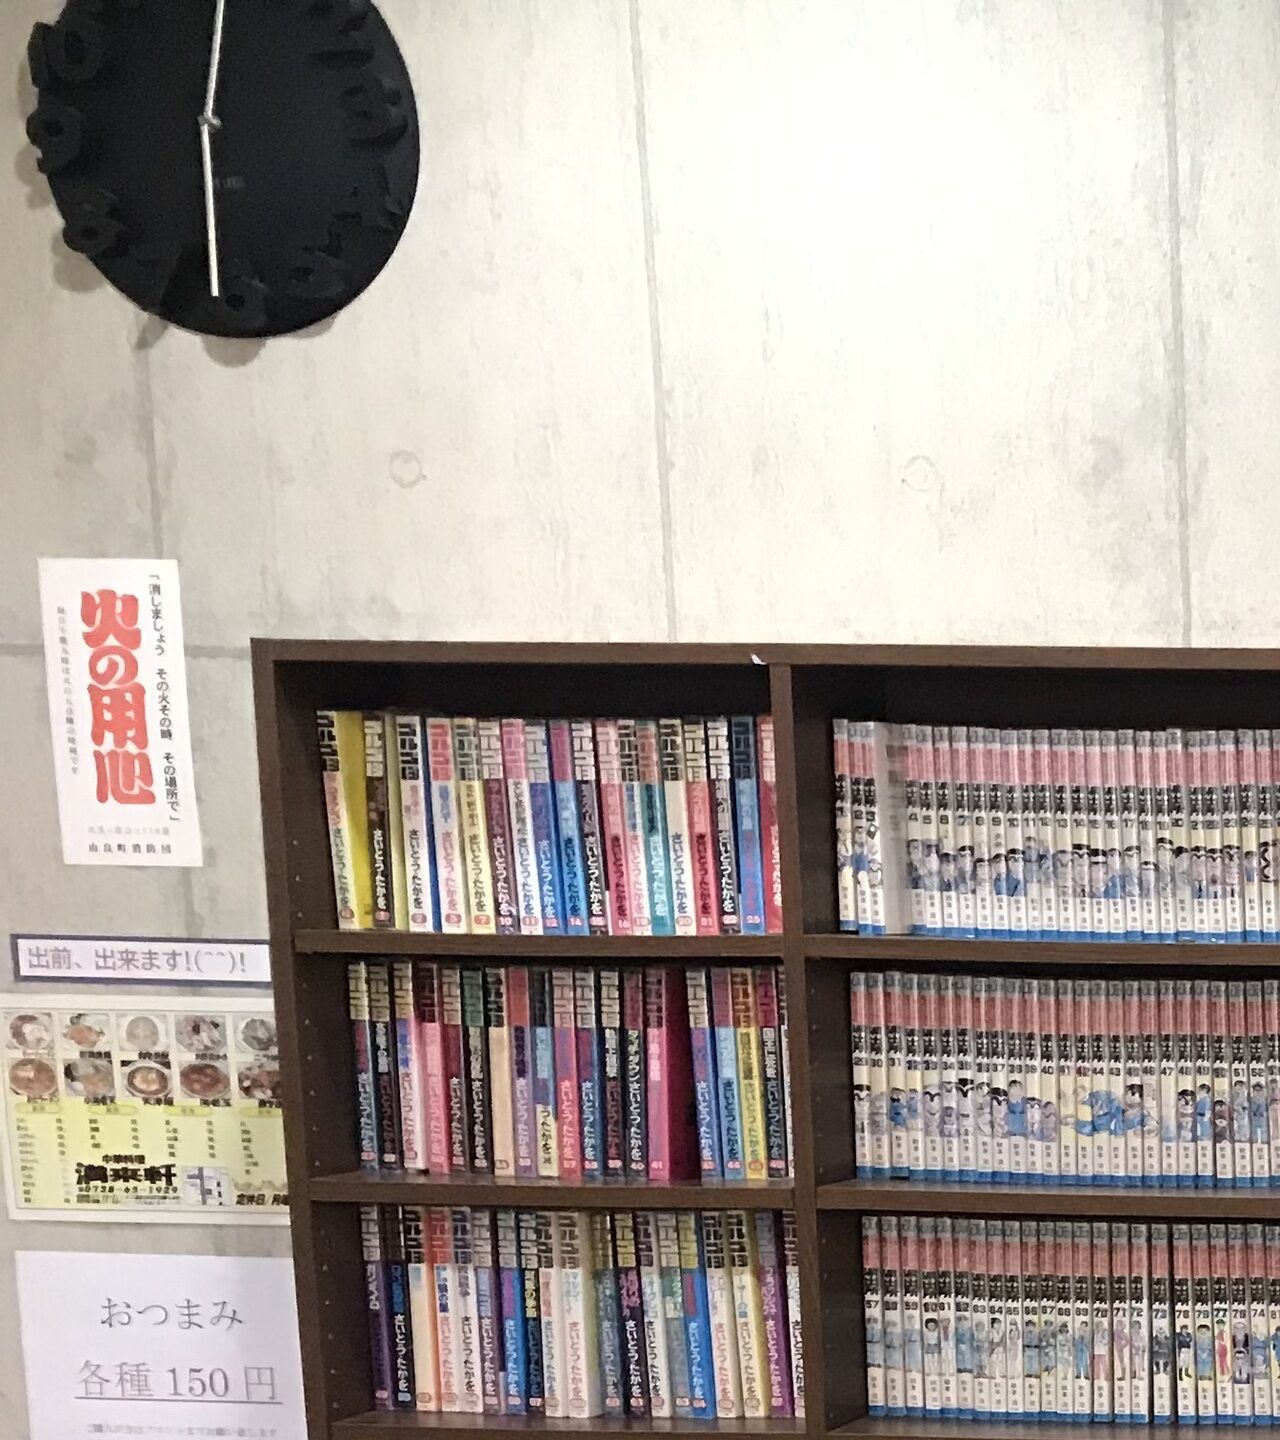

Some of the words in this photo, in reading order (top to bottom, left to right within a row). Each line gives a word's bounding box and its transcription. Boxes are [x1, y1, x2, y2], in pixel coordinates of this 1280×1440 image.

[80, 588, 156, 805] 火の用心
[163, 752, 180, 823] その場所で」
[373, 829, 387, 909] さいとうたかを
[409, 829, 423, 909] さいとうたかを
[493, 836, 511, 916] さいとうたかを
[101, 1298, 243, 1331] おつまみ
[78, 1359, 154, 1397] 各種
[166, 1367, 229, 1397] 150
[244, 1366, 275, 1400] 円
